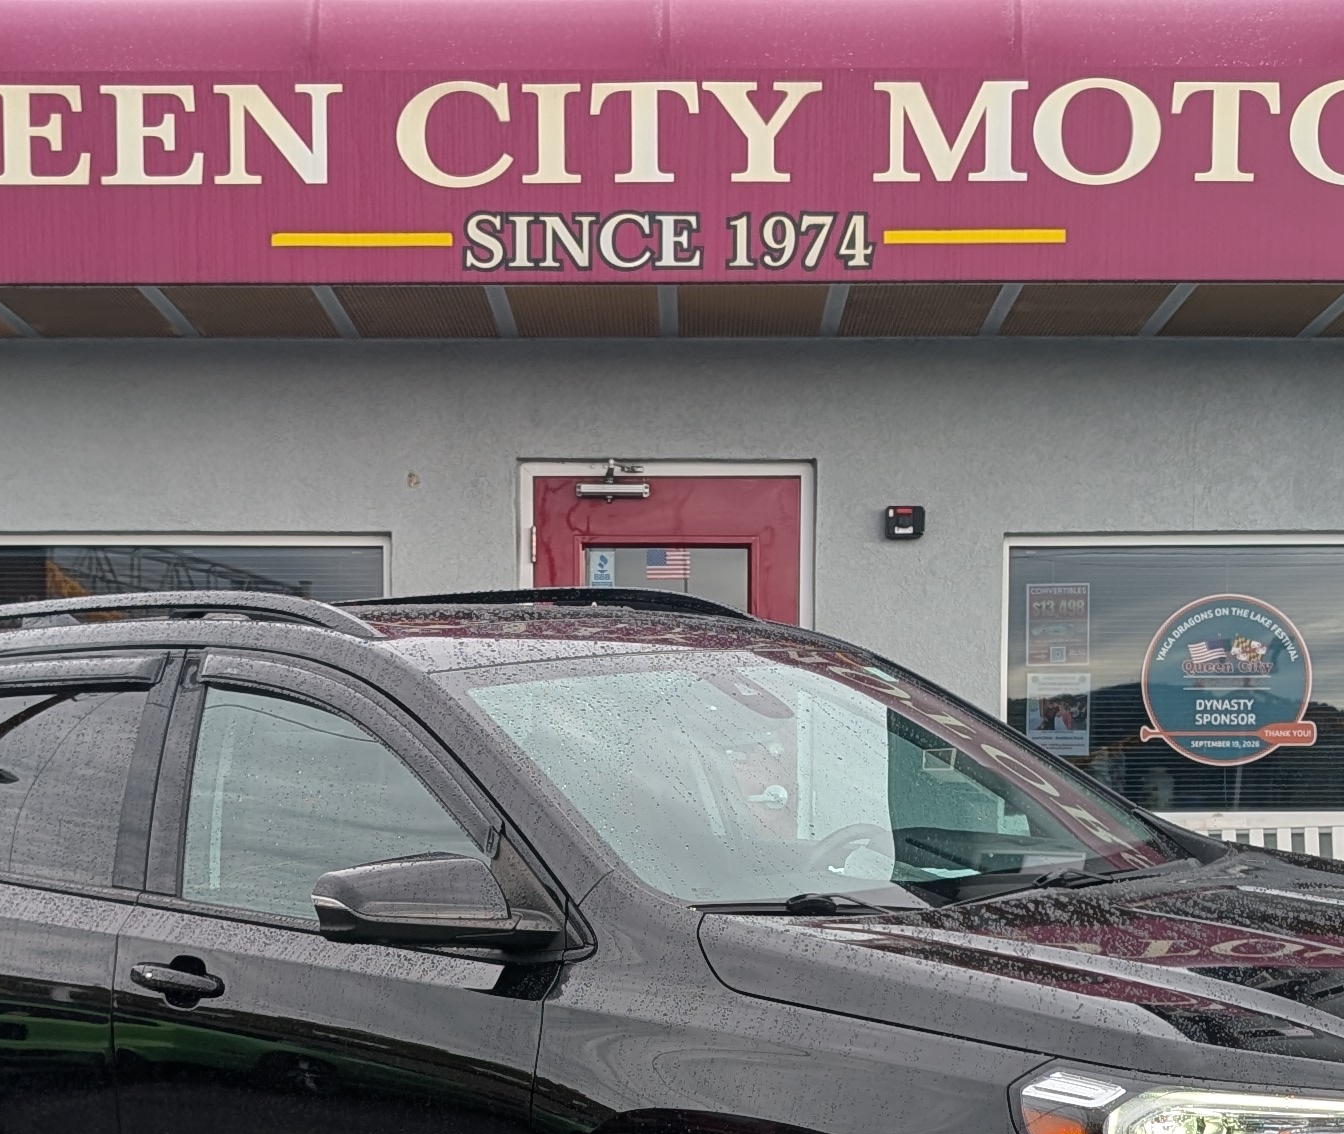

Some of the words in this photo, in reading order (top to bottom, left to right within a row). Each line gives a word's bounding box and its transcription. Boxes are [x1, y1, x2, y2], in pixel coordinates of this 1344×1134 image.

[395, 80, 823, 189] CITY
[462, 210, 702, 271] SINCE
[724, 210, 874, 270] 1974
[593, 573, 611, 581] BBB
[1030, 586, 1087, 595] CONVERTIBLES
[1156, 637, 1175, 662] YMCA
[1172, 609, 1214, 639] DRAGONS
[1214, 607, 1230, 617] ON
[1231, 607, 1249, 618] THE
[1249, 610, 1272, 628] LAKE
[1270, 624, 1300, 662] FESTIVAL
[1182, 660, 1234, 676] Queen
[1238, 660, 1274, 676] City
[1195, 699, 1255, 711] DYNASTY
[1194, 713, 1256, 726] SPONSOR
[1263, 729, 1291, 738] THANK
[1292, 729, 1312, 738] YOU!
[1190, 740, 1231, 748] SEPTEMBER
